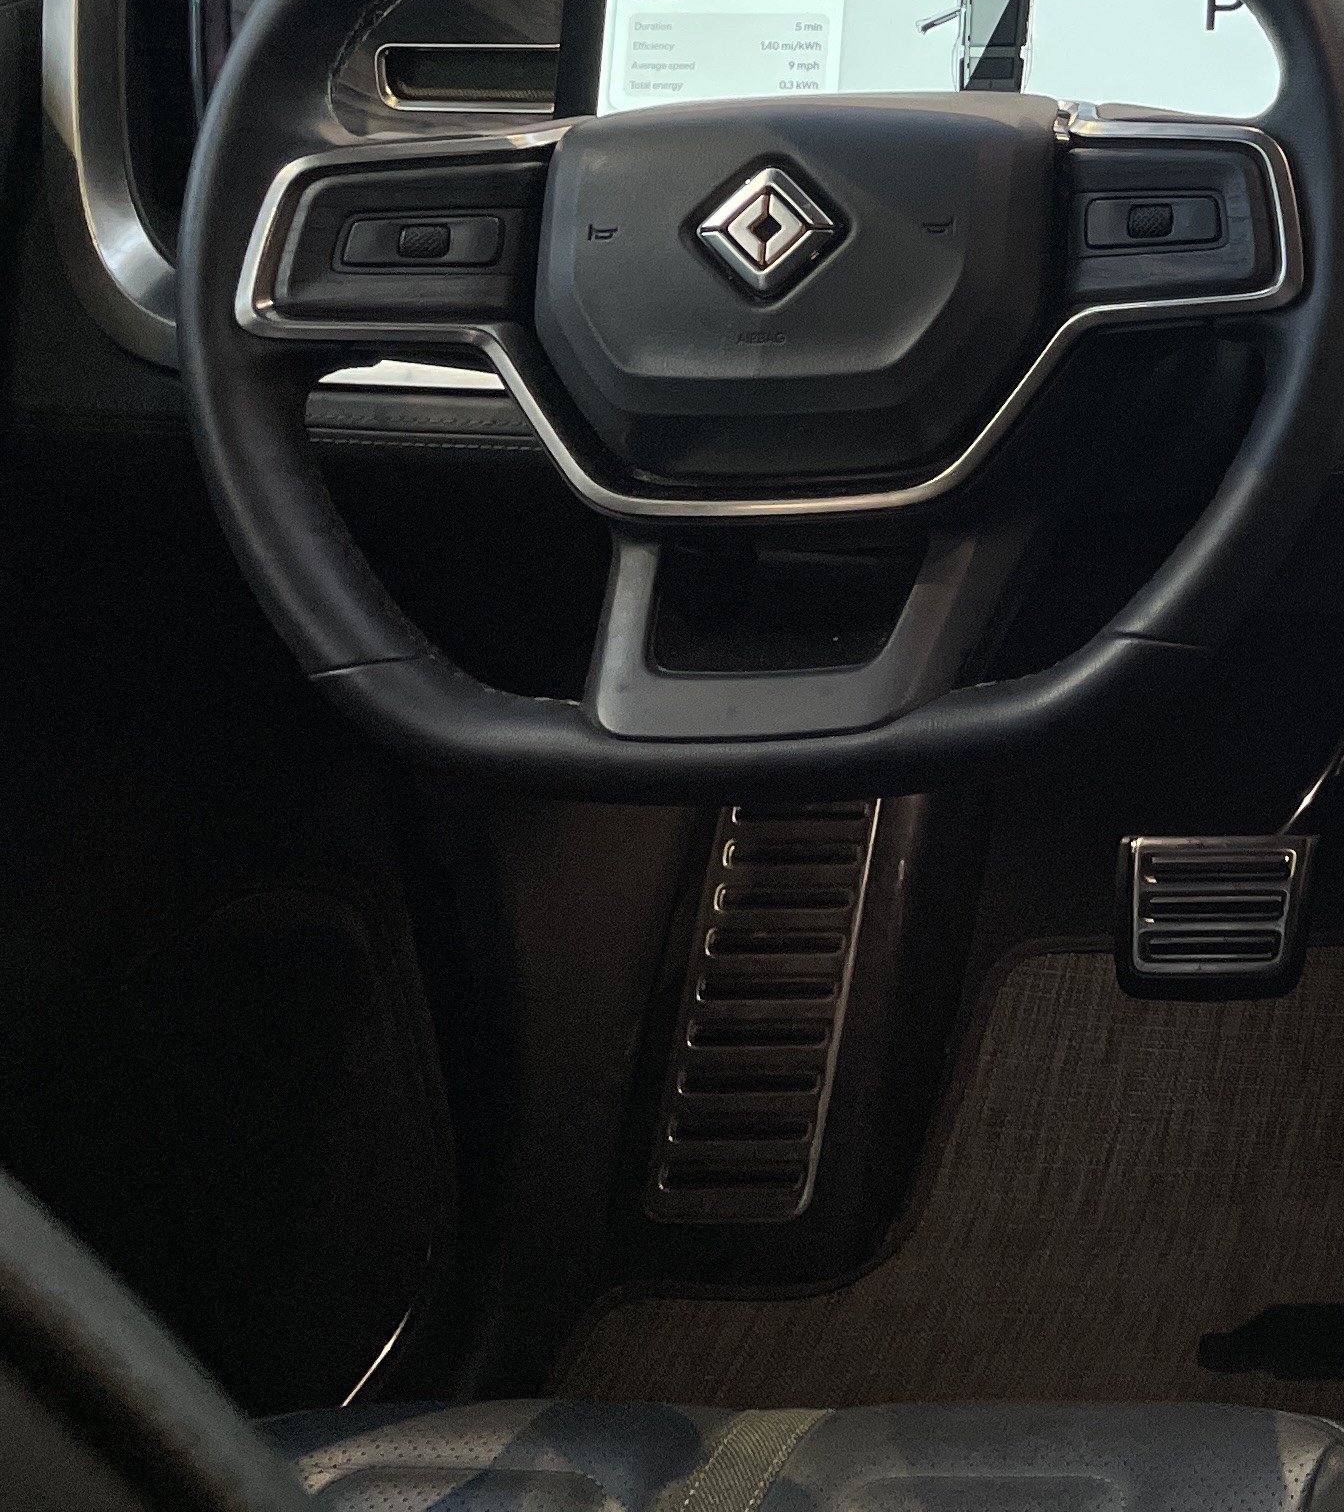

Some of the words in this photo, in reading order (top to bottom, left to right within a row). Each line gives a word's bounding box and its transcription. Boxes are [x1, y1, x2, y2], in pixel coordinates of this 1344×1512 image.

[634, 22, 672, 31] Duration
[794, 22, 803, 31] 5
[804, 23, 823, 31] min
[633, 41, 675, 51] Efficiency
[781, 40, 822, 52] mi/kWh
[631, 61, 669, 71] Average
[670, 61, 696, 71] speed
[796, 61, 820, 71] mph
[629, 80, 651, 90] Total
[652, 82, 684, 92] energy
[796, 80, 819, 90] kWh
